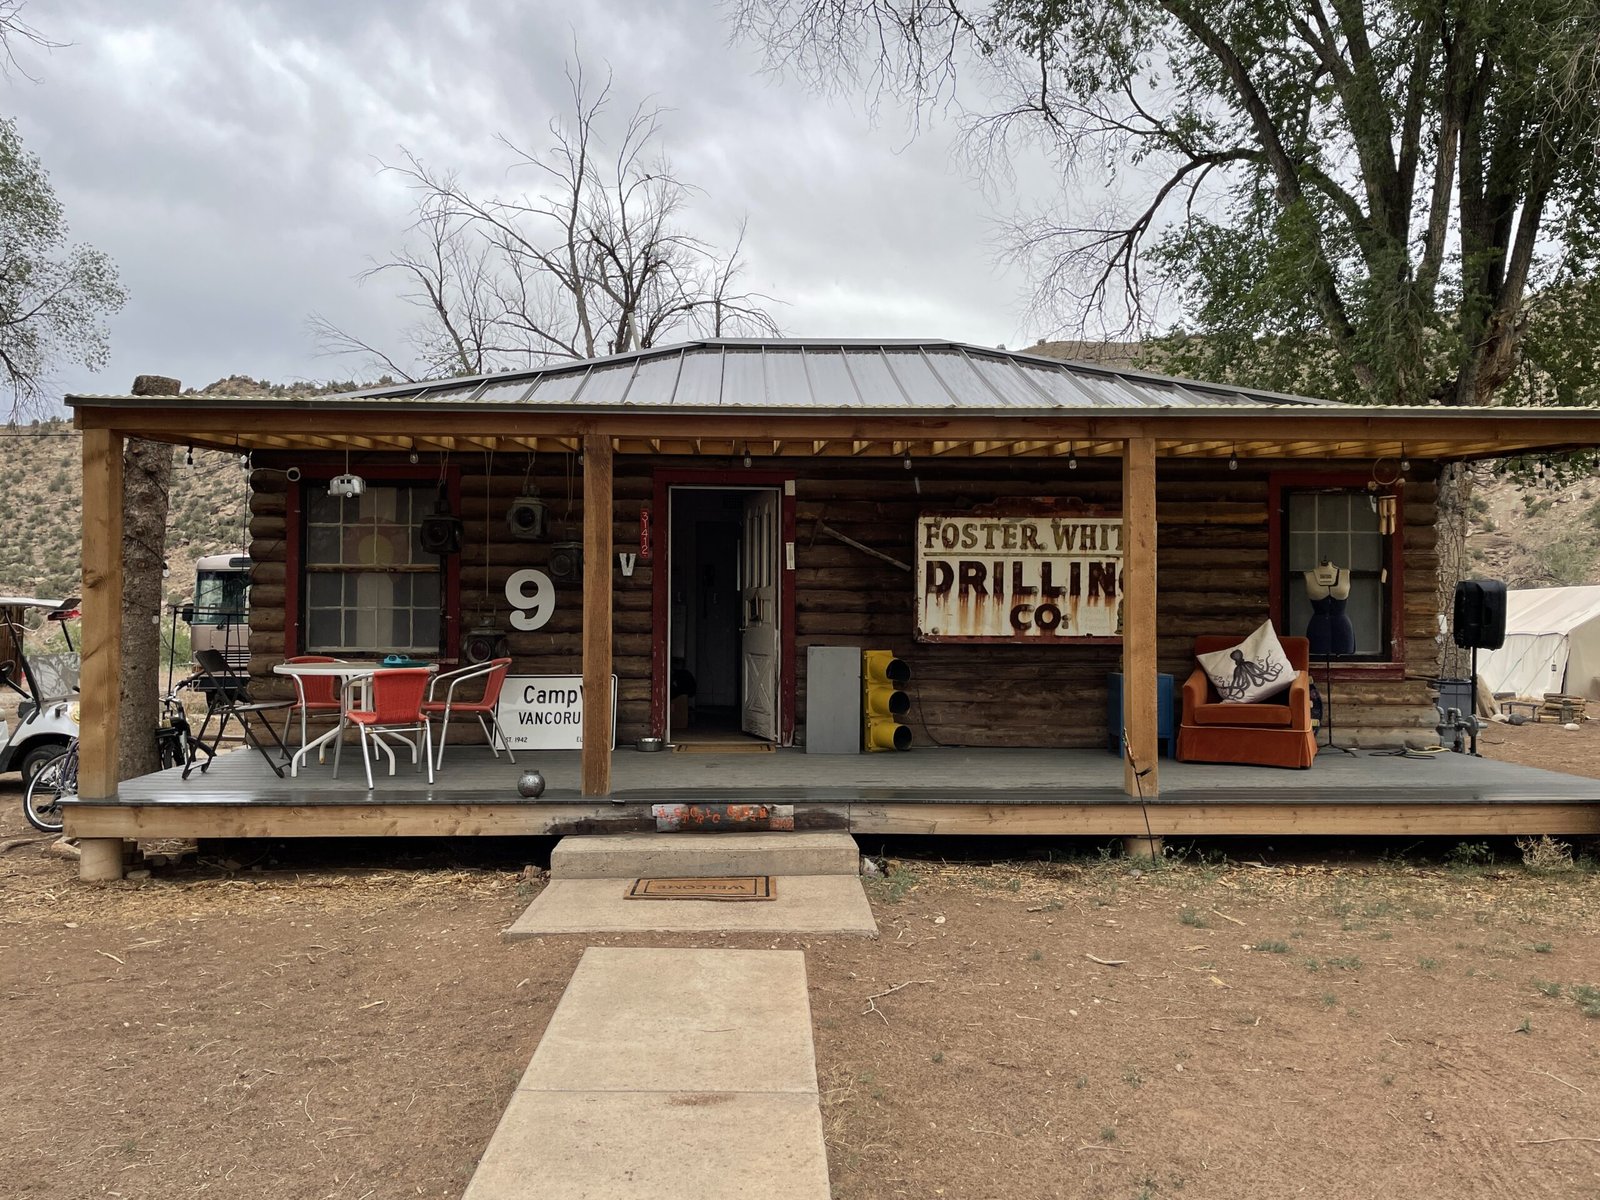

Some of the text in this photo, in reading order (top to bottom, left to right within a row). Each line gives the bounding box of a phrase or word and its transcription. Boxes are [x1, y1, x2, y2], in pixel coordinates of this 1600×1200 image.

[641, 511, 649, 555] 31412
[923, 522, 1043, 551] FOSTER
[619, 552, 637, 577] V
[925, 560, 1123, 598] DRILLIN
[505, 568, 556, 631] 9
[518, 711, 581, 725] VANCORU
